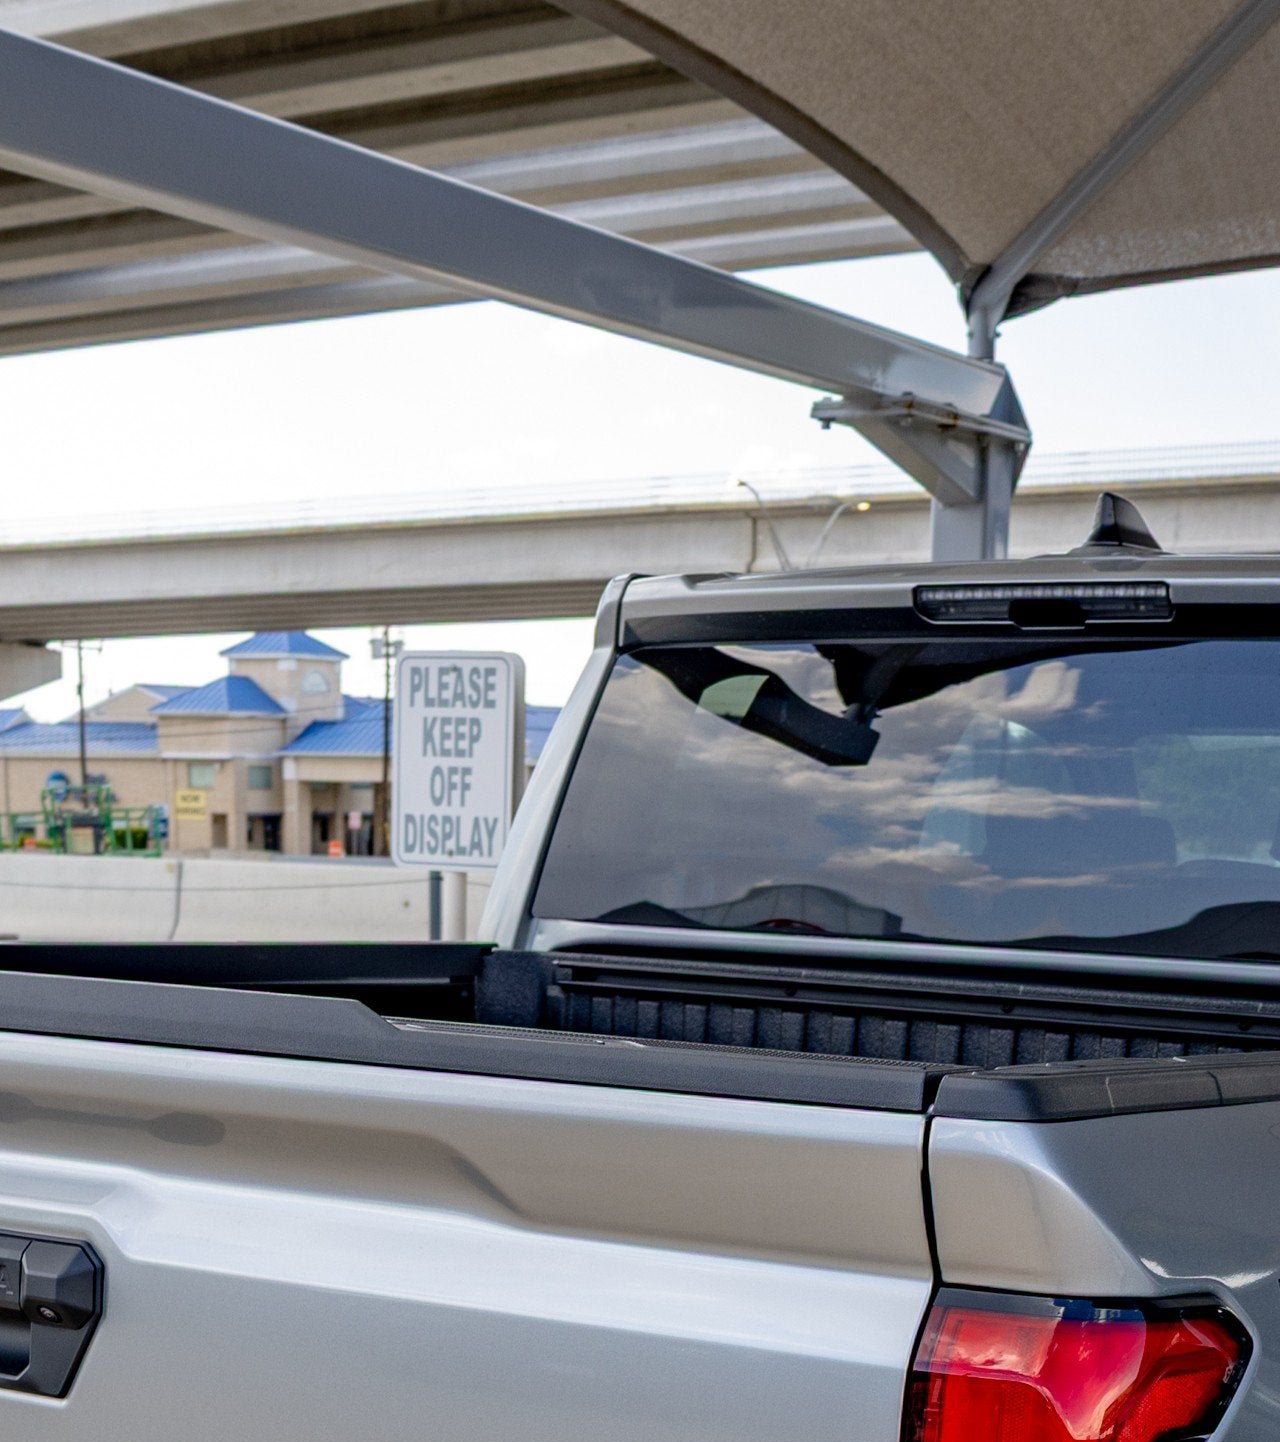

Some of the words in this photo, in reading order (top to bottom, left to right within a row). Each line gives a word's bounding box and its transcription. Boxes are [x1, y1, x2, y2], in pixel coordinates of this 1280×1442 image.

[410, 666, 497, 709] PLEASE
[422, 717, 482, 758] KEEP
[430, 766, 473, 807] OFF
[403, 814, 499, 858] DISPLAY
